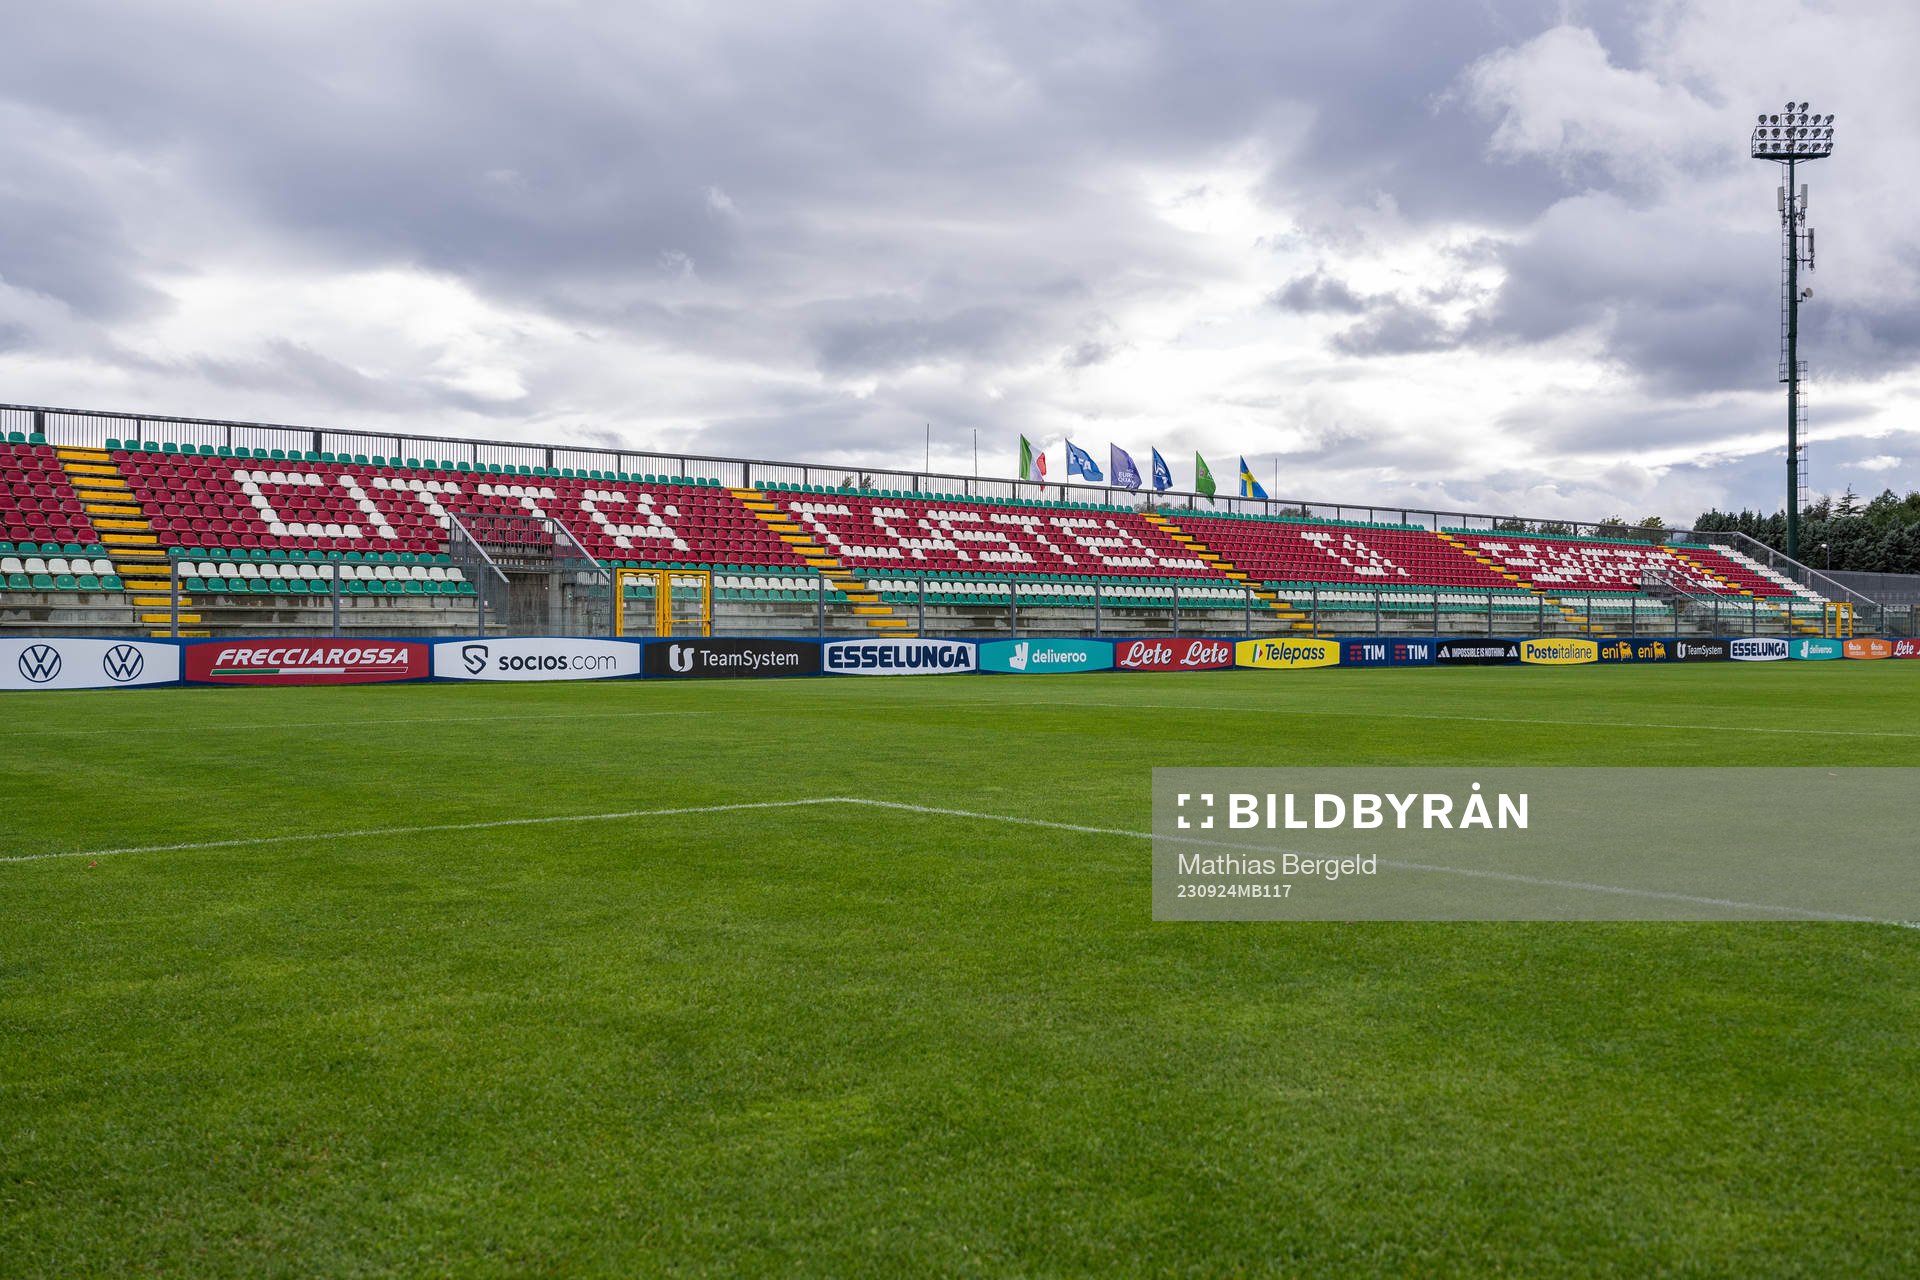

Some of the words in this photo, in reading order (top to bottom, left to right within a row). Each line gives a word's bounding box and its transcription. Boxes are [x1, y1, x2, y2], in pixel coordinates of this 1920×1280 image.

[1120, 641, 1172, 667] Lete
[1180, 641, 1229, 666] Lete
[1265, 642, 1325, 664] Telepass
[1363, 644, 1385, 661] TIM
[1407, 644, 1428, 660] TIM
[1602, 646, 1618, 659] eni
[1638, 646, 1653, 659] eni
[1687, 645, 1723, 657] TeamSystem
[1732, 642, 1787, 657] ESSELUNGA
[1894, 640, 1914, 656] Lete
[215, 648, 409, 666] FRECCIAROSSA
[700, 649, 799, 669] TeamSystem
[828, 645, 970, 668] ESSELUNGA
[1032, 649, 1087, 664] deliveroo
